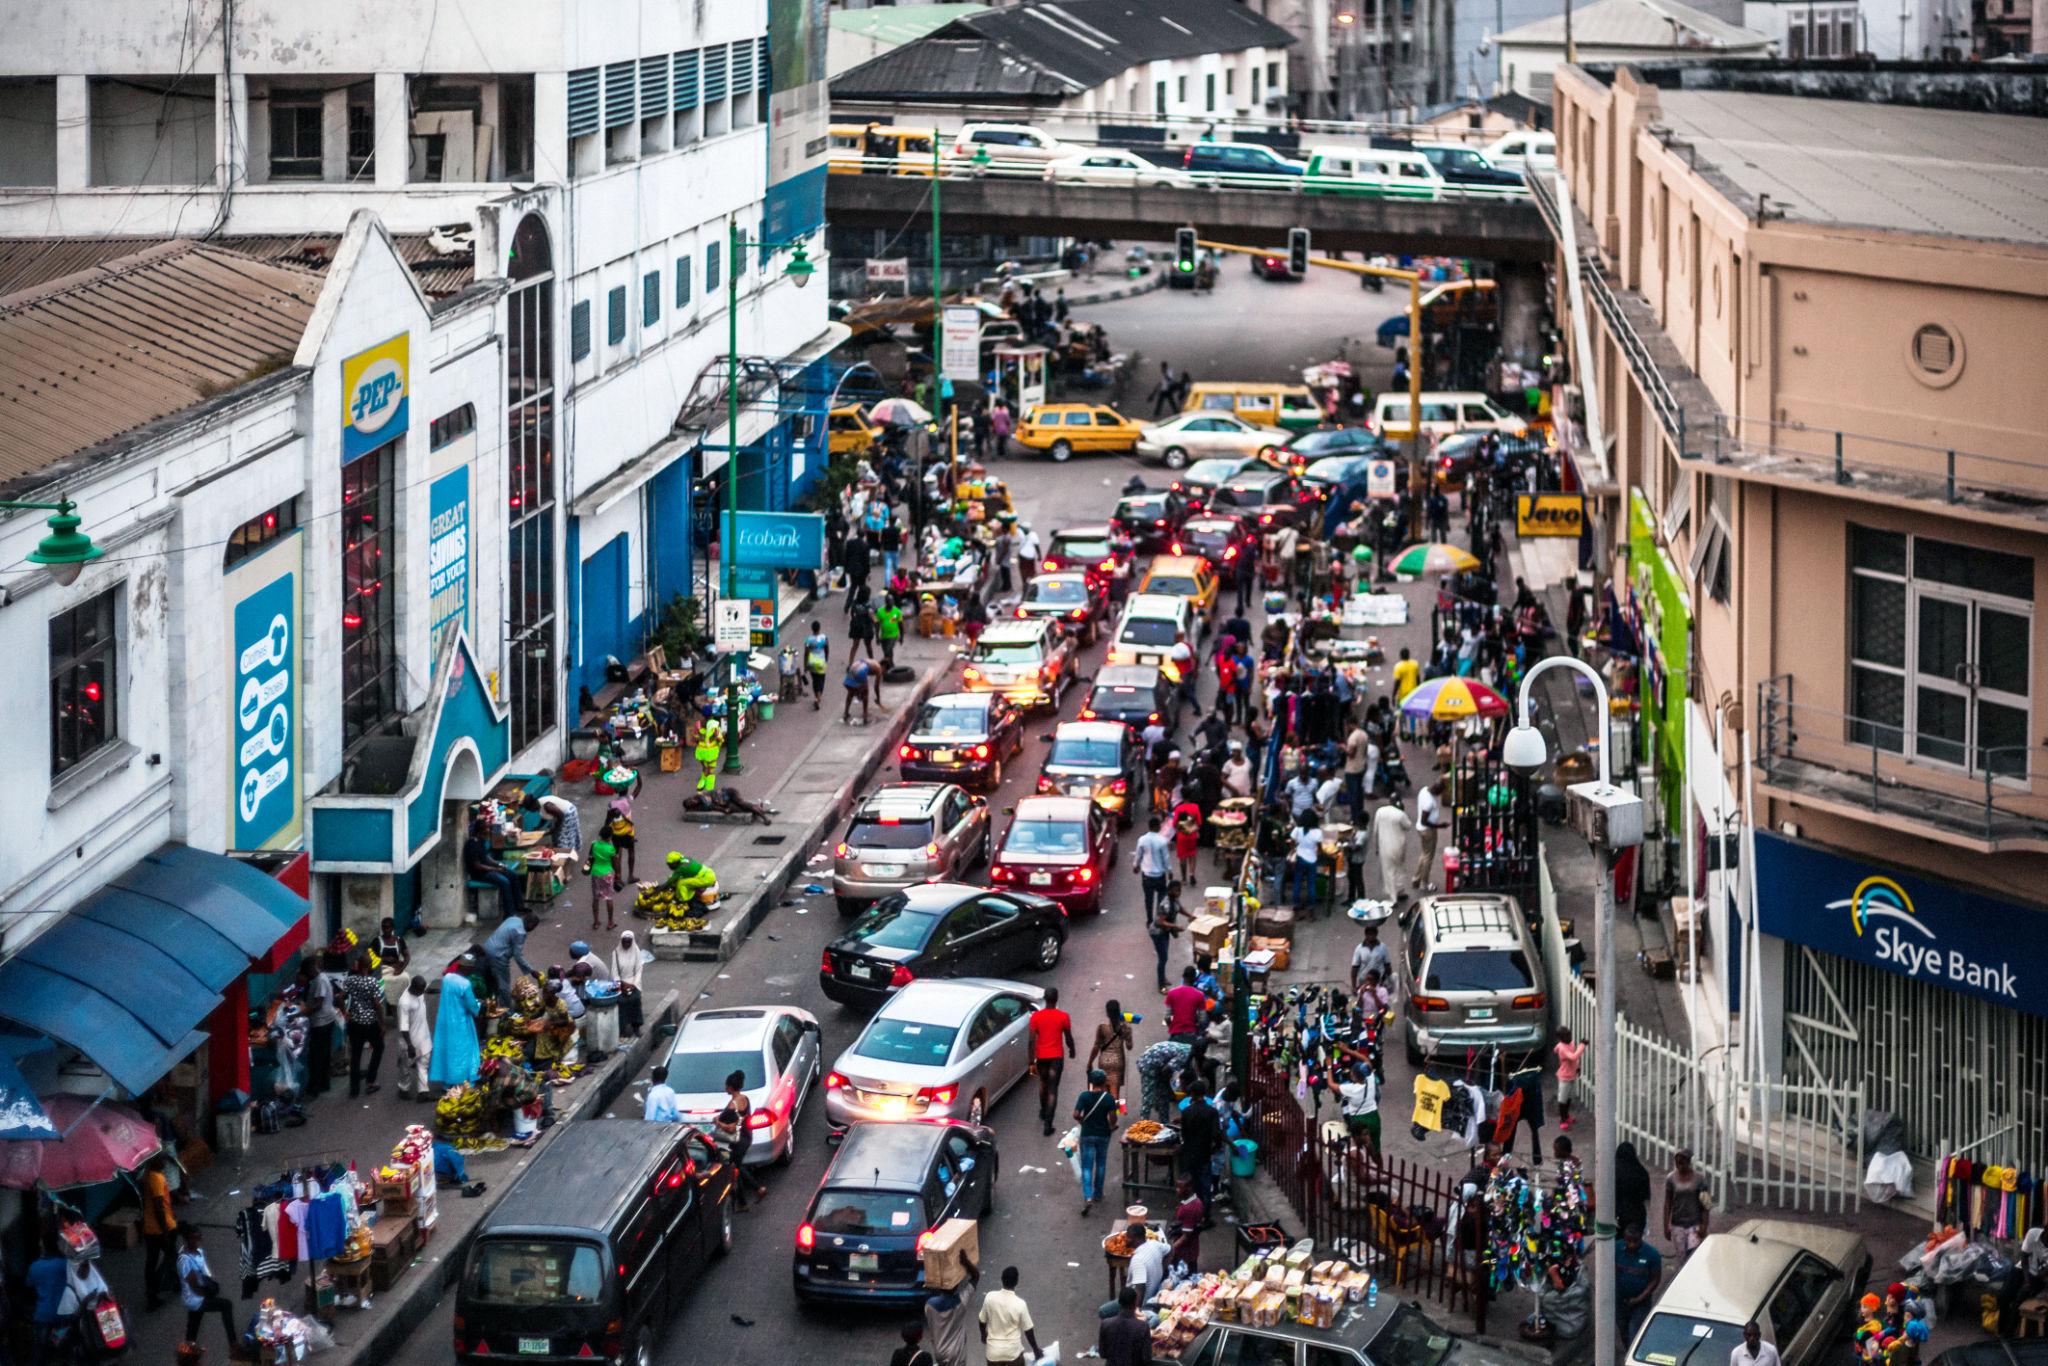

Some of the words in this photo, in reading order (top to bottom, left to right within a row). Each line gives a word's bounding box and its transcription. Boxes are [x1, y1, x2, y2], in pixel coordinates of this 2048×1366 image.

[352, 371, 402, 421] PEP
[432, 501, 466, 539] GREAT
[739, 526, 801, 548] Ecobank
[431, 571, 446, 595] FOR
[446, 558, 466, 584] YOUR
[264, 679, 284, 701] Shoes
[245, 738, 265, 760] Home
[1875, 926, 1942, 975] Skye
[1949, 950, 2018, 998] Bank
